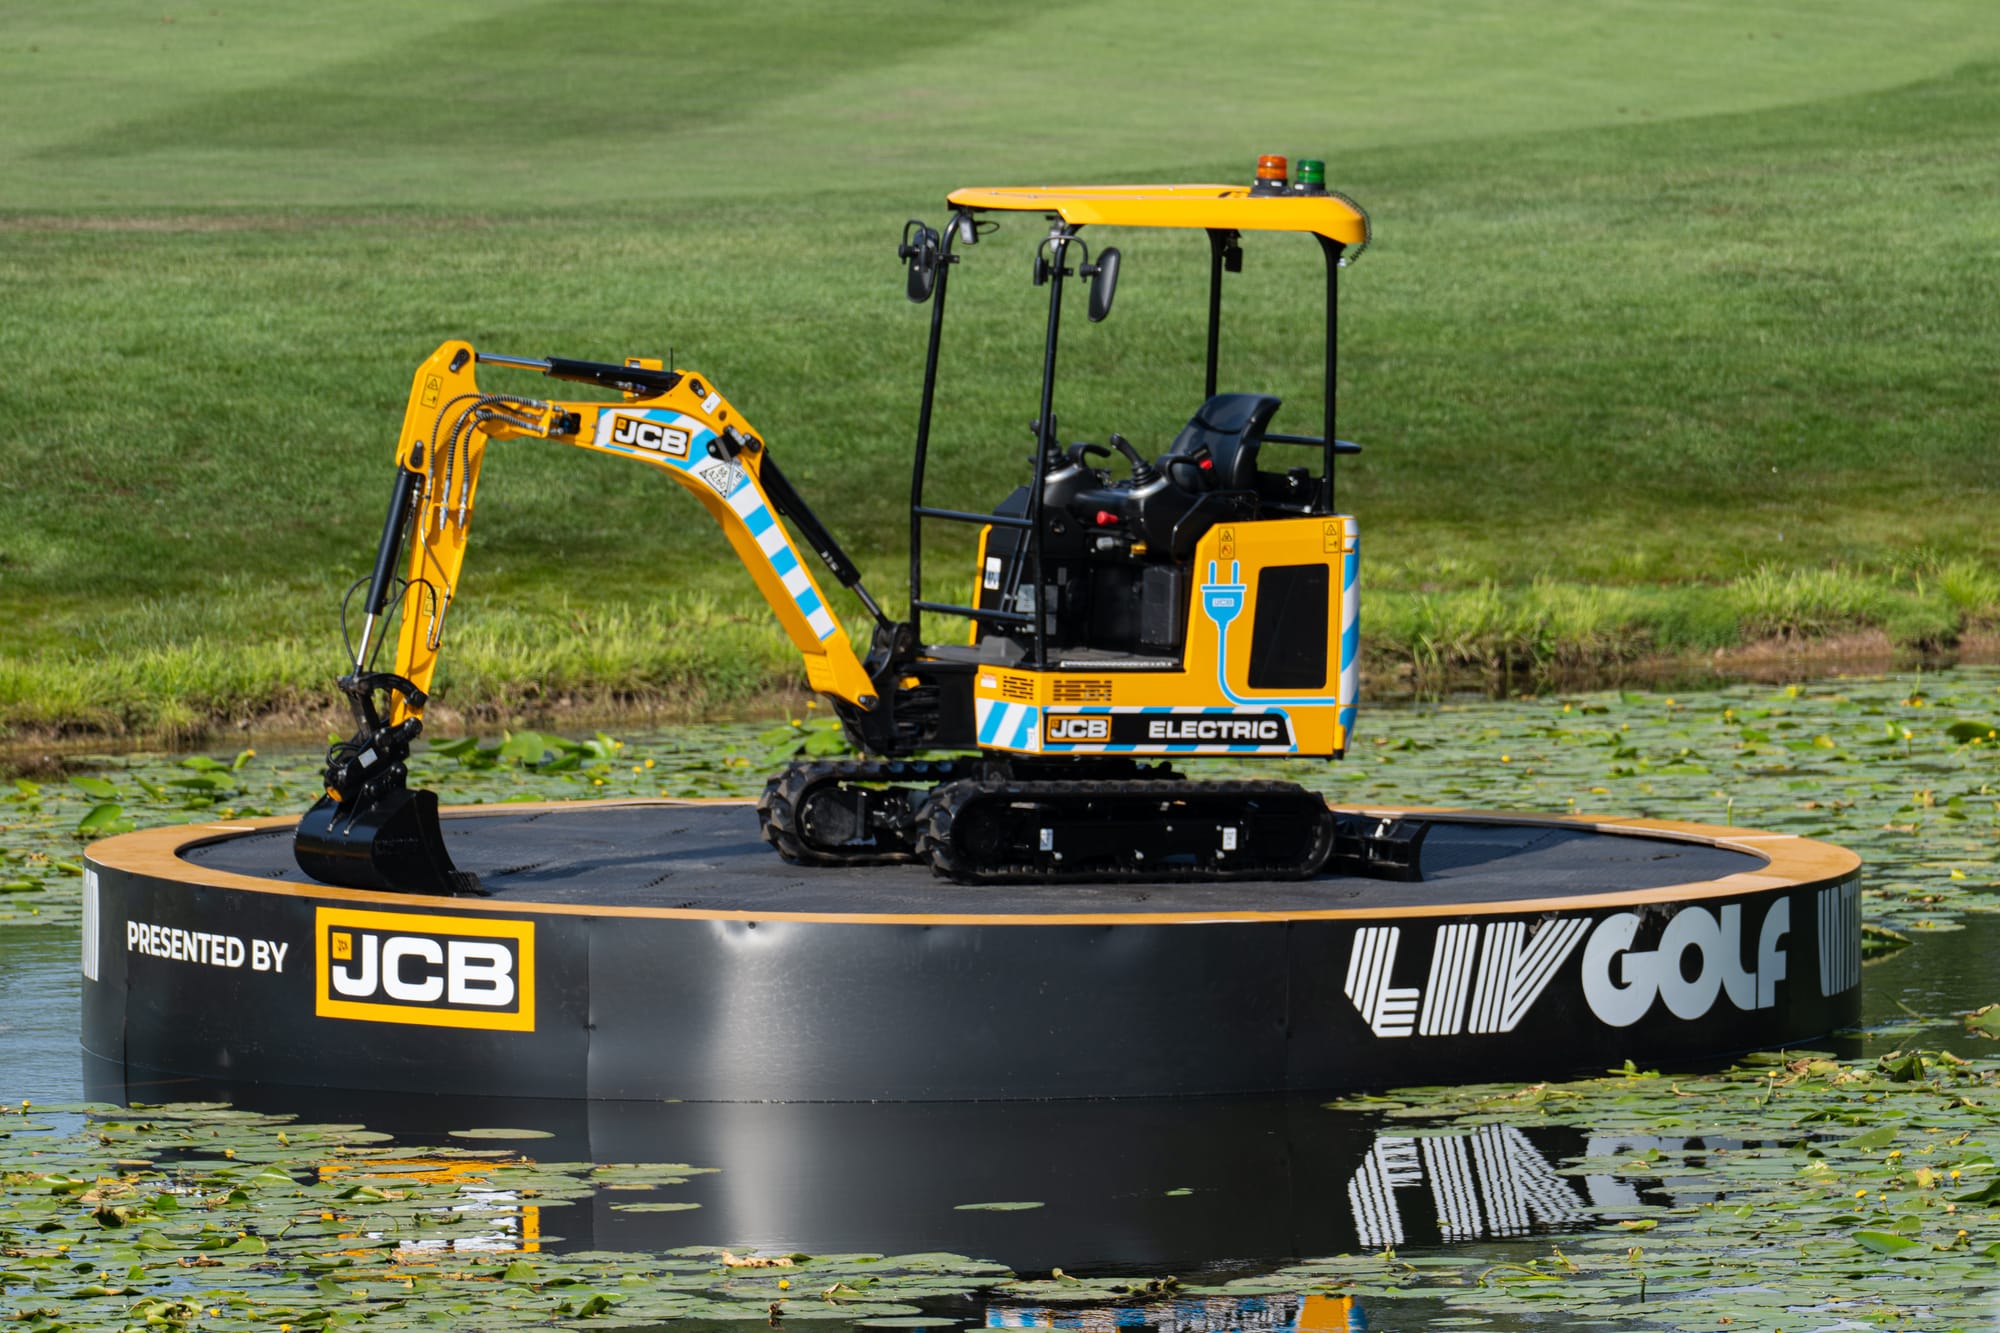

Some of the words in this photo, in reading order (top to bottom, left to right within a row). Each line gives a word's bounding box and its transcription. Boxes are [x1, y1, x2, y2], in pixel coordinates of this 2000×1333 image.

[614, 421, 688, 455] JCB
[1051, 720, 1107, 738] JCB
[1149, 721, 1279, 739] ELECTRIC
[127, 921, 245, 968] PRESENTED
[252, 938, 288, 973] BY
[332, 934, 514, 1006] JCB
[1344, 917, 1592, 1038] LIV
